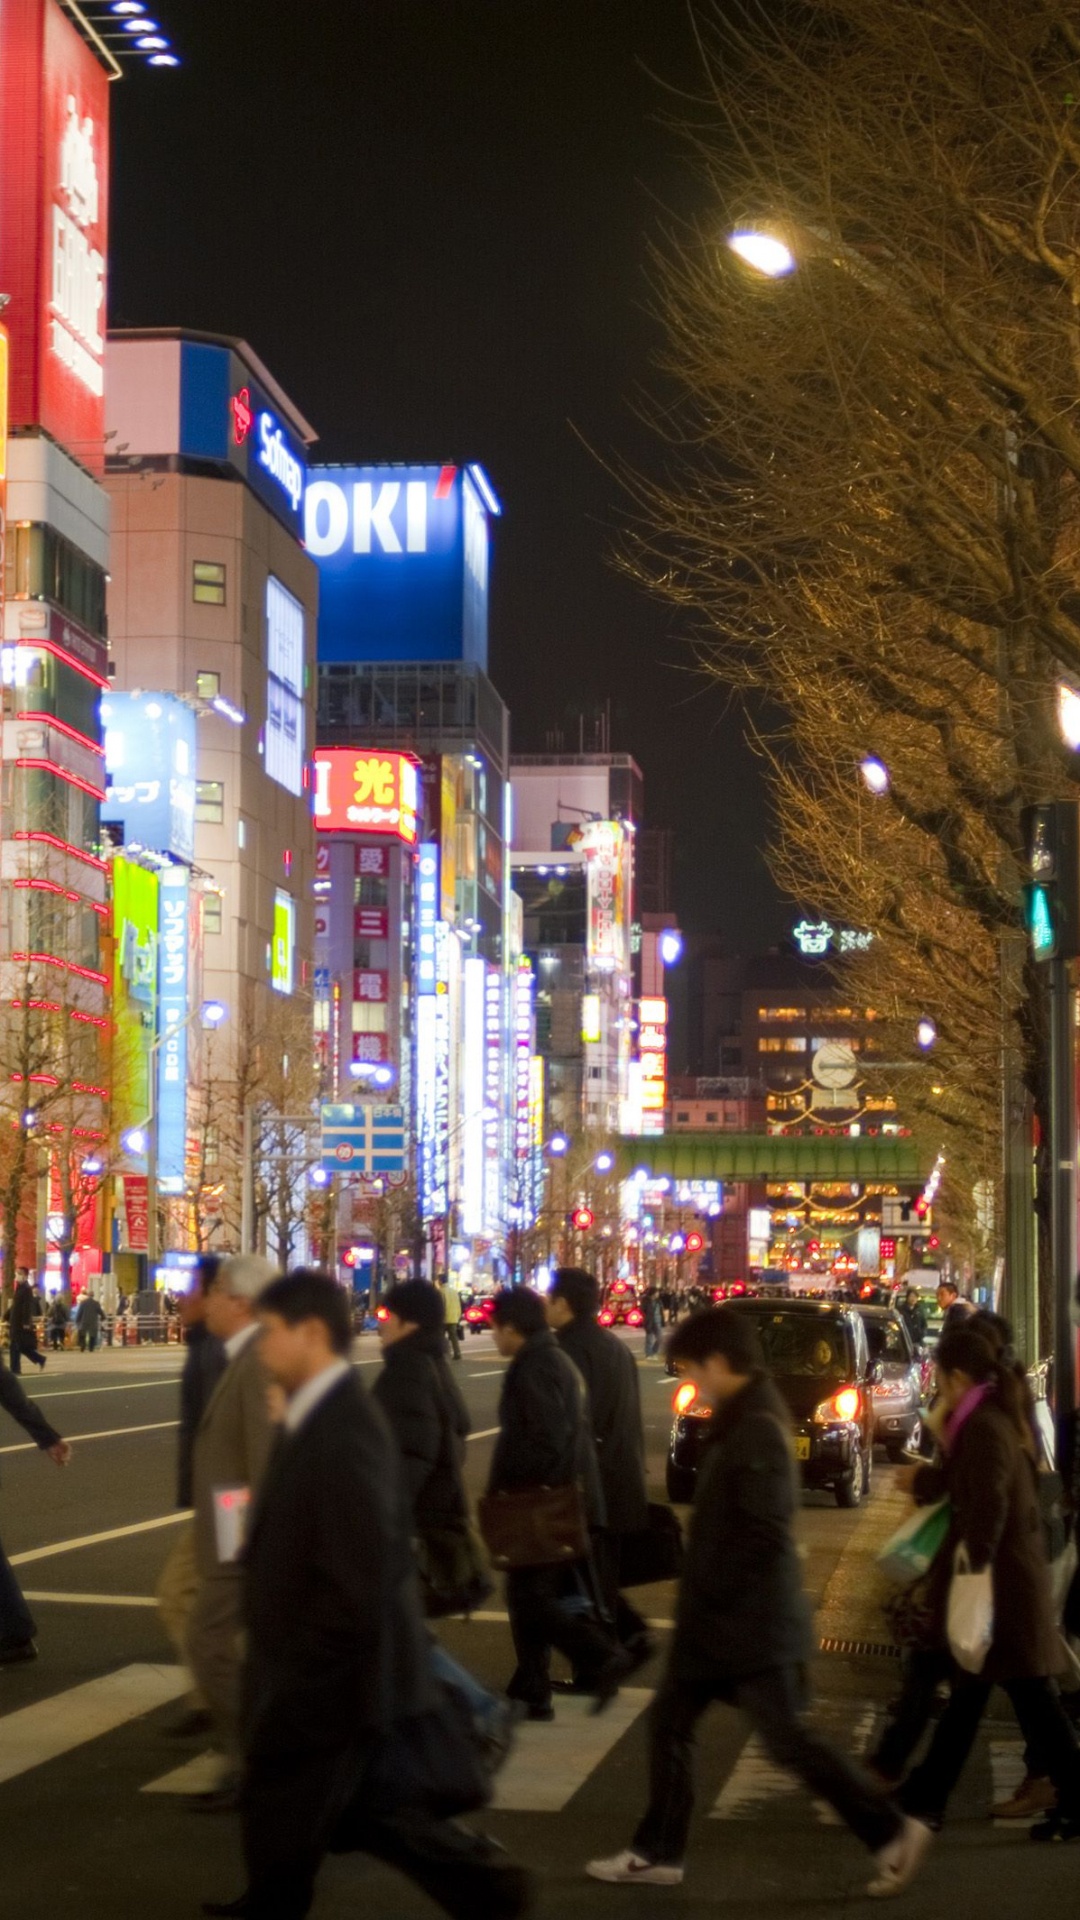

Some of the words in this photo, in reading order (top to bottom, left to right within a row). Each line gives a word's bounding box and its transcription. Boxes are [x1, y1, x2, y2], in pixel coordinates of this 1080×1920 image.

[260, 411, 302, 511] Sofmap
[304, 481, 427, 557] OKI
[353, 758, 395, 804] 光
[357, 847, 384, 1062] 愛三電機
